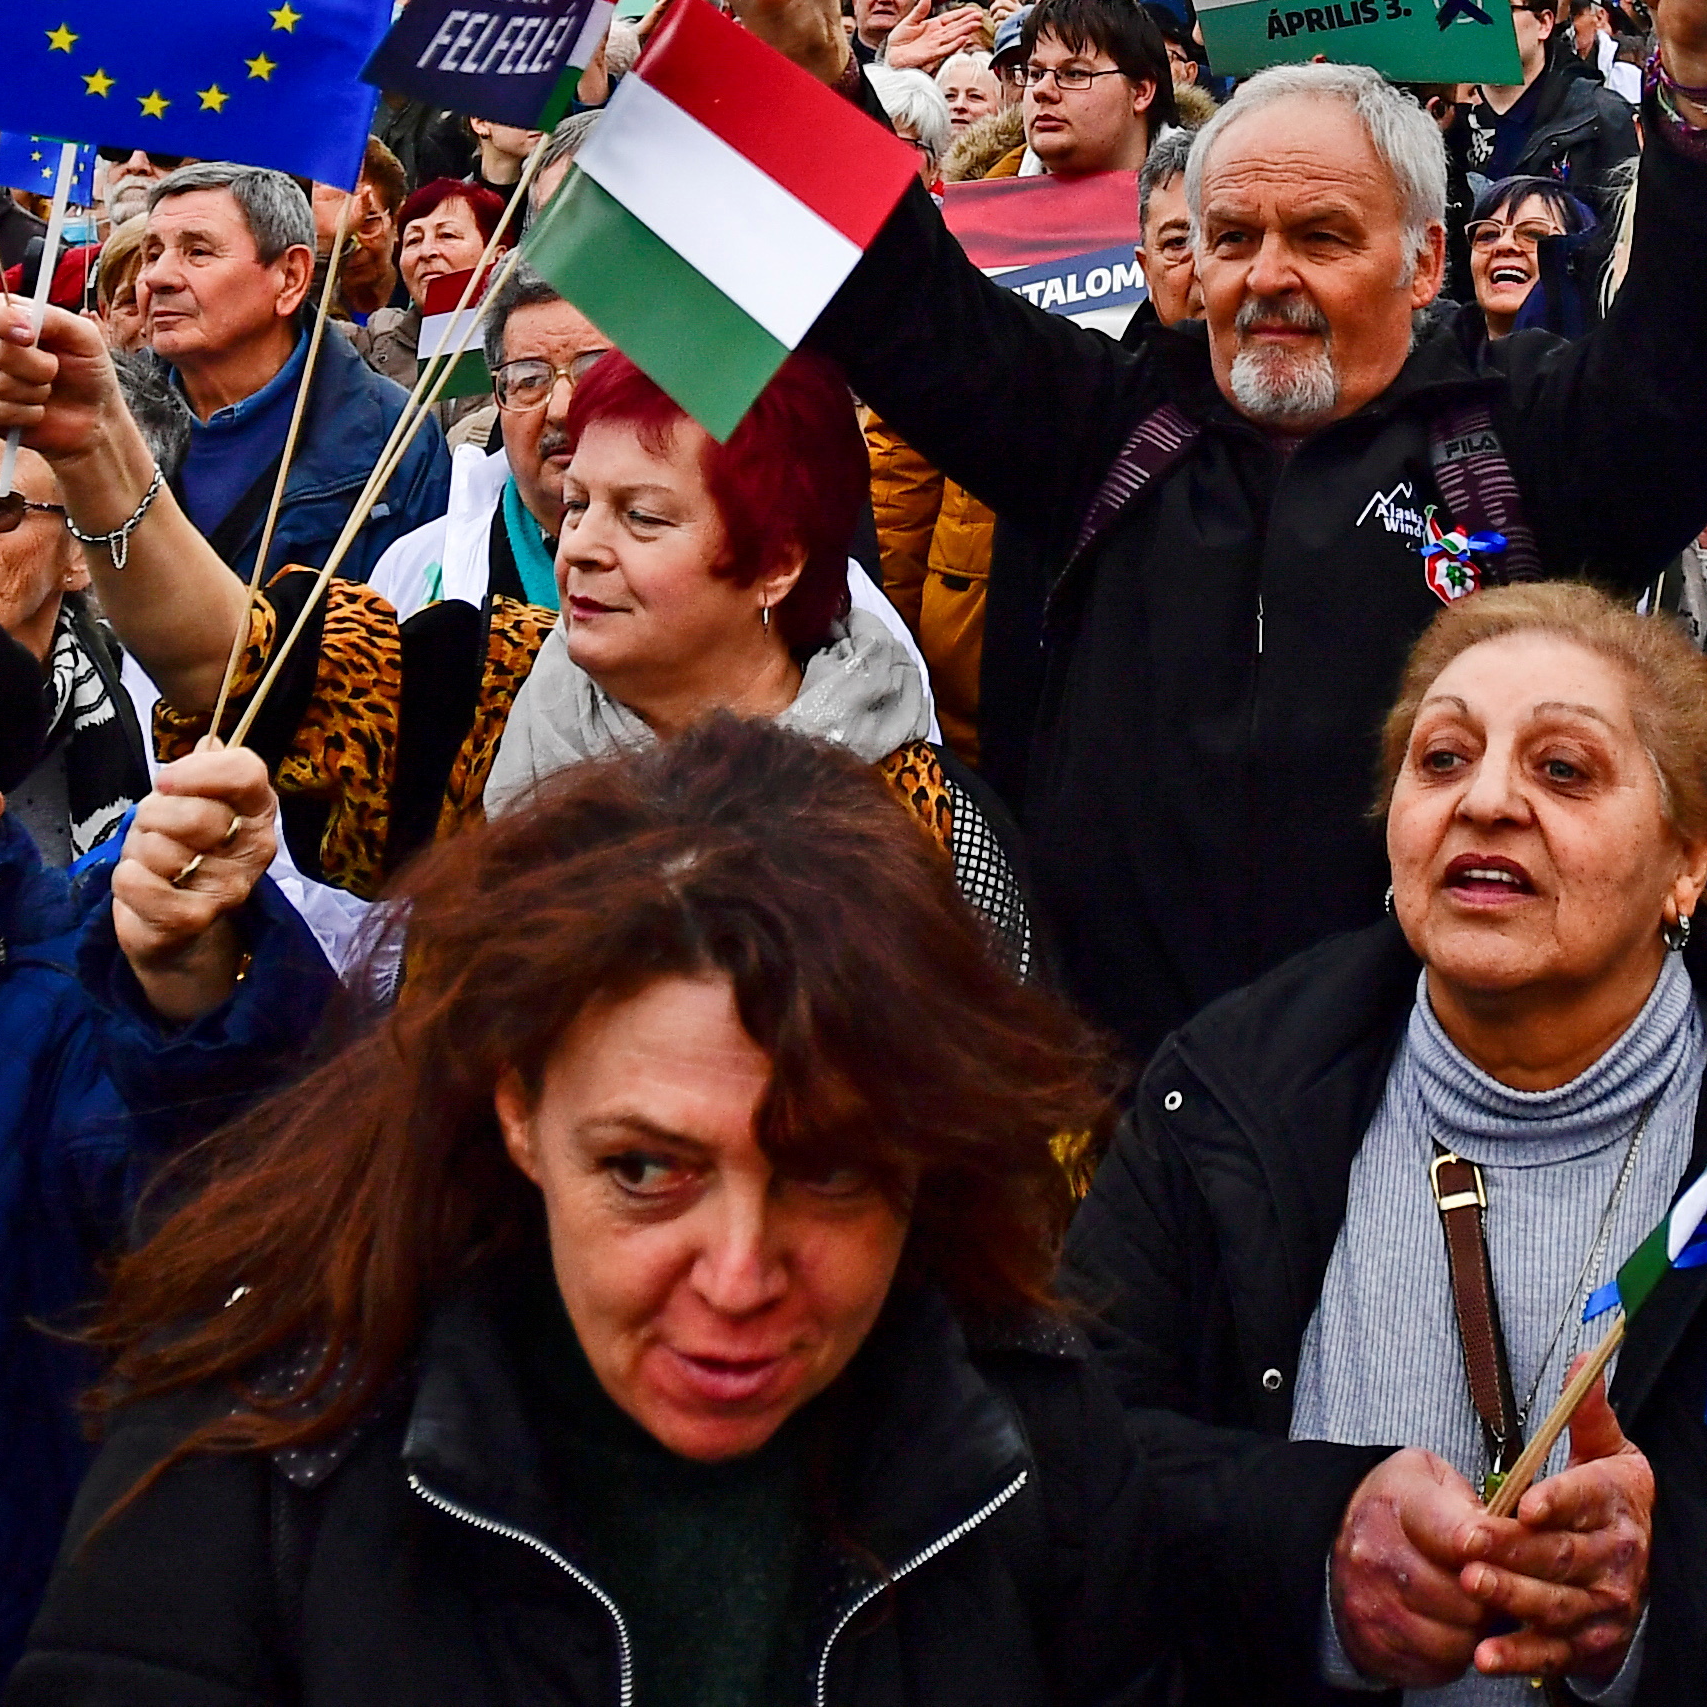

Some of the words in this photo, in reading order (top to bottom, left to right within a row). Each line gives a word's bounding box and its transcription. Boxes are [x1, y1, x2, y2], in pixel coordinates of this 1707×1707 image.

[416, 2, 578, 75] FELFELÉ!
[1011, 260, 1145, 310] TALOM
[1445, 432, 1499, 459] FILA
[1383, 516, 1423, 539] Wind
